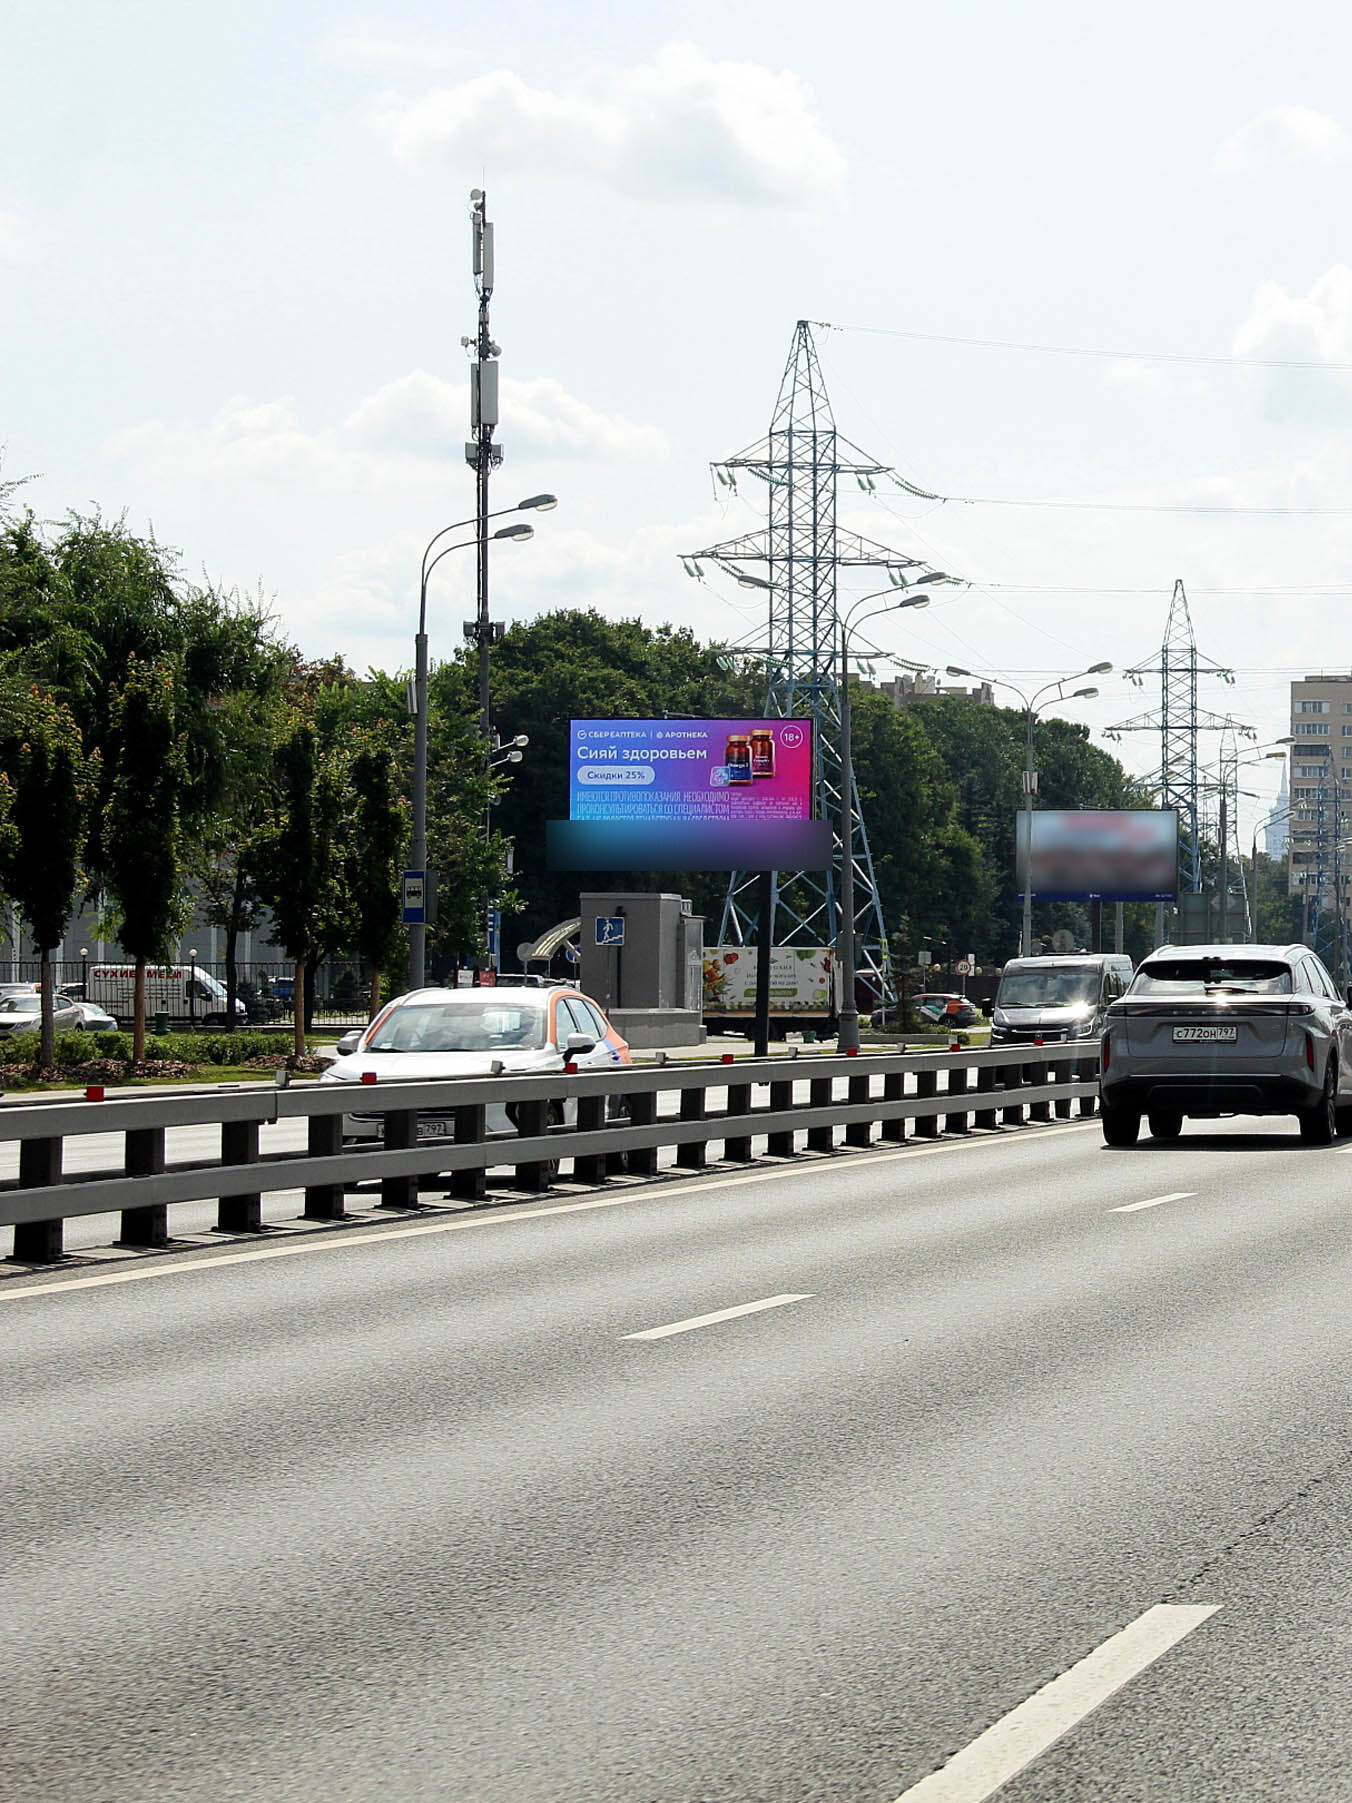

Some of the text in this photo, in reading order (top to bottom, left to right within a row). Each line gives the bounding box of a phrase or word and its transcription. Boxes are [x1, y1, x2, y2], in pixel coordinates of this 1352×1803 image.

[784, 732, 800, 742] 18+
[577, 745, 707, 762] Сияй здоровьем
[587, 770, 645, 780] Скидки 25%
